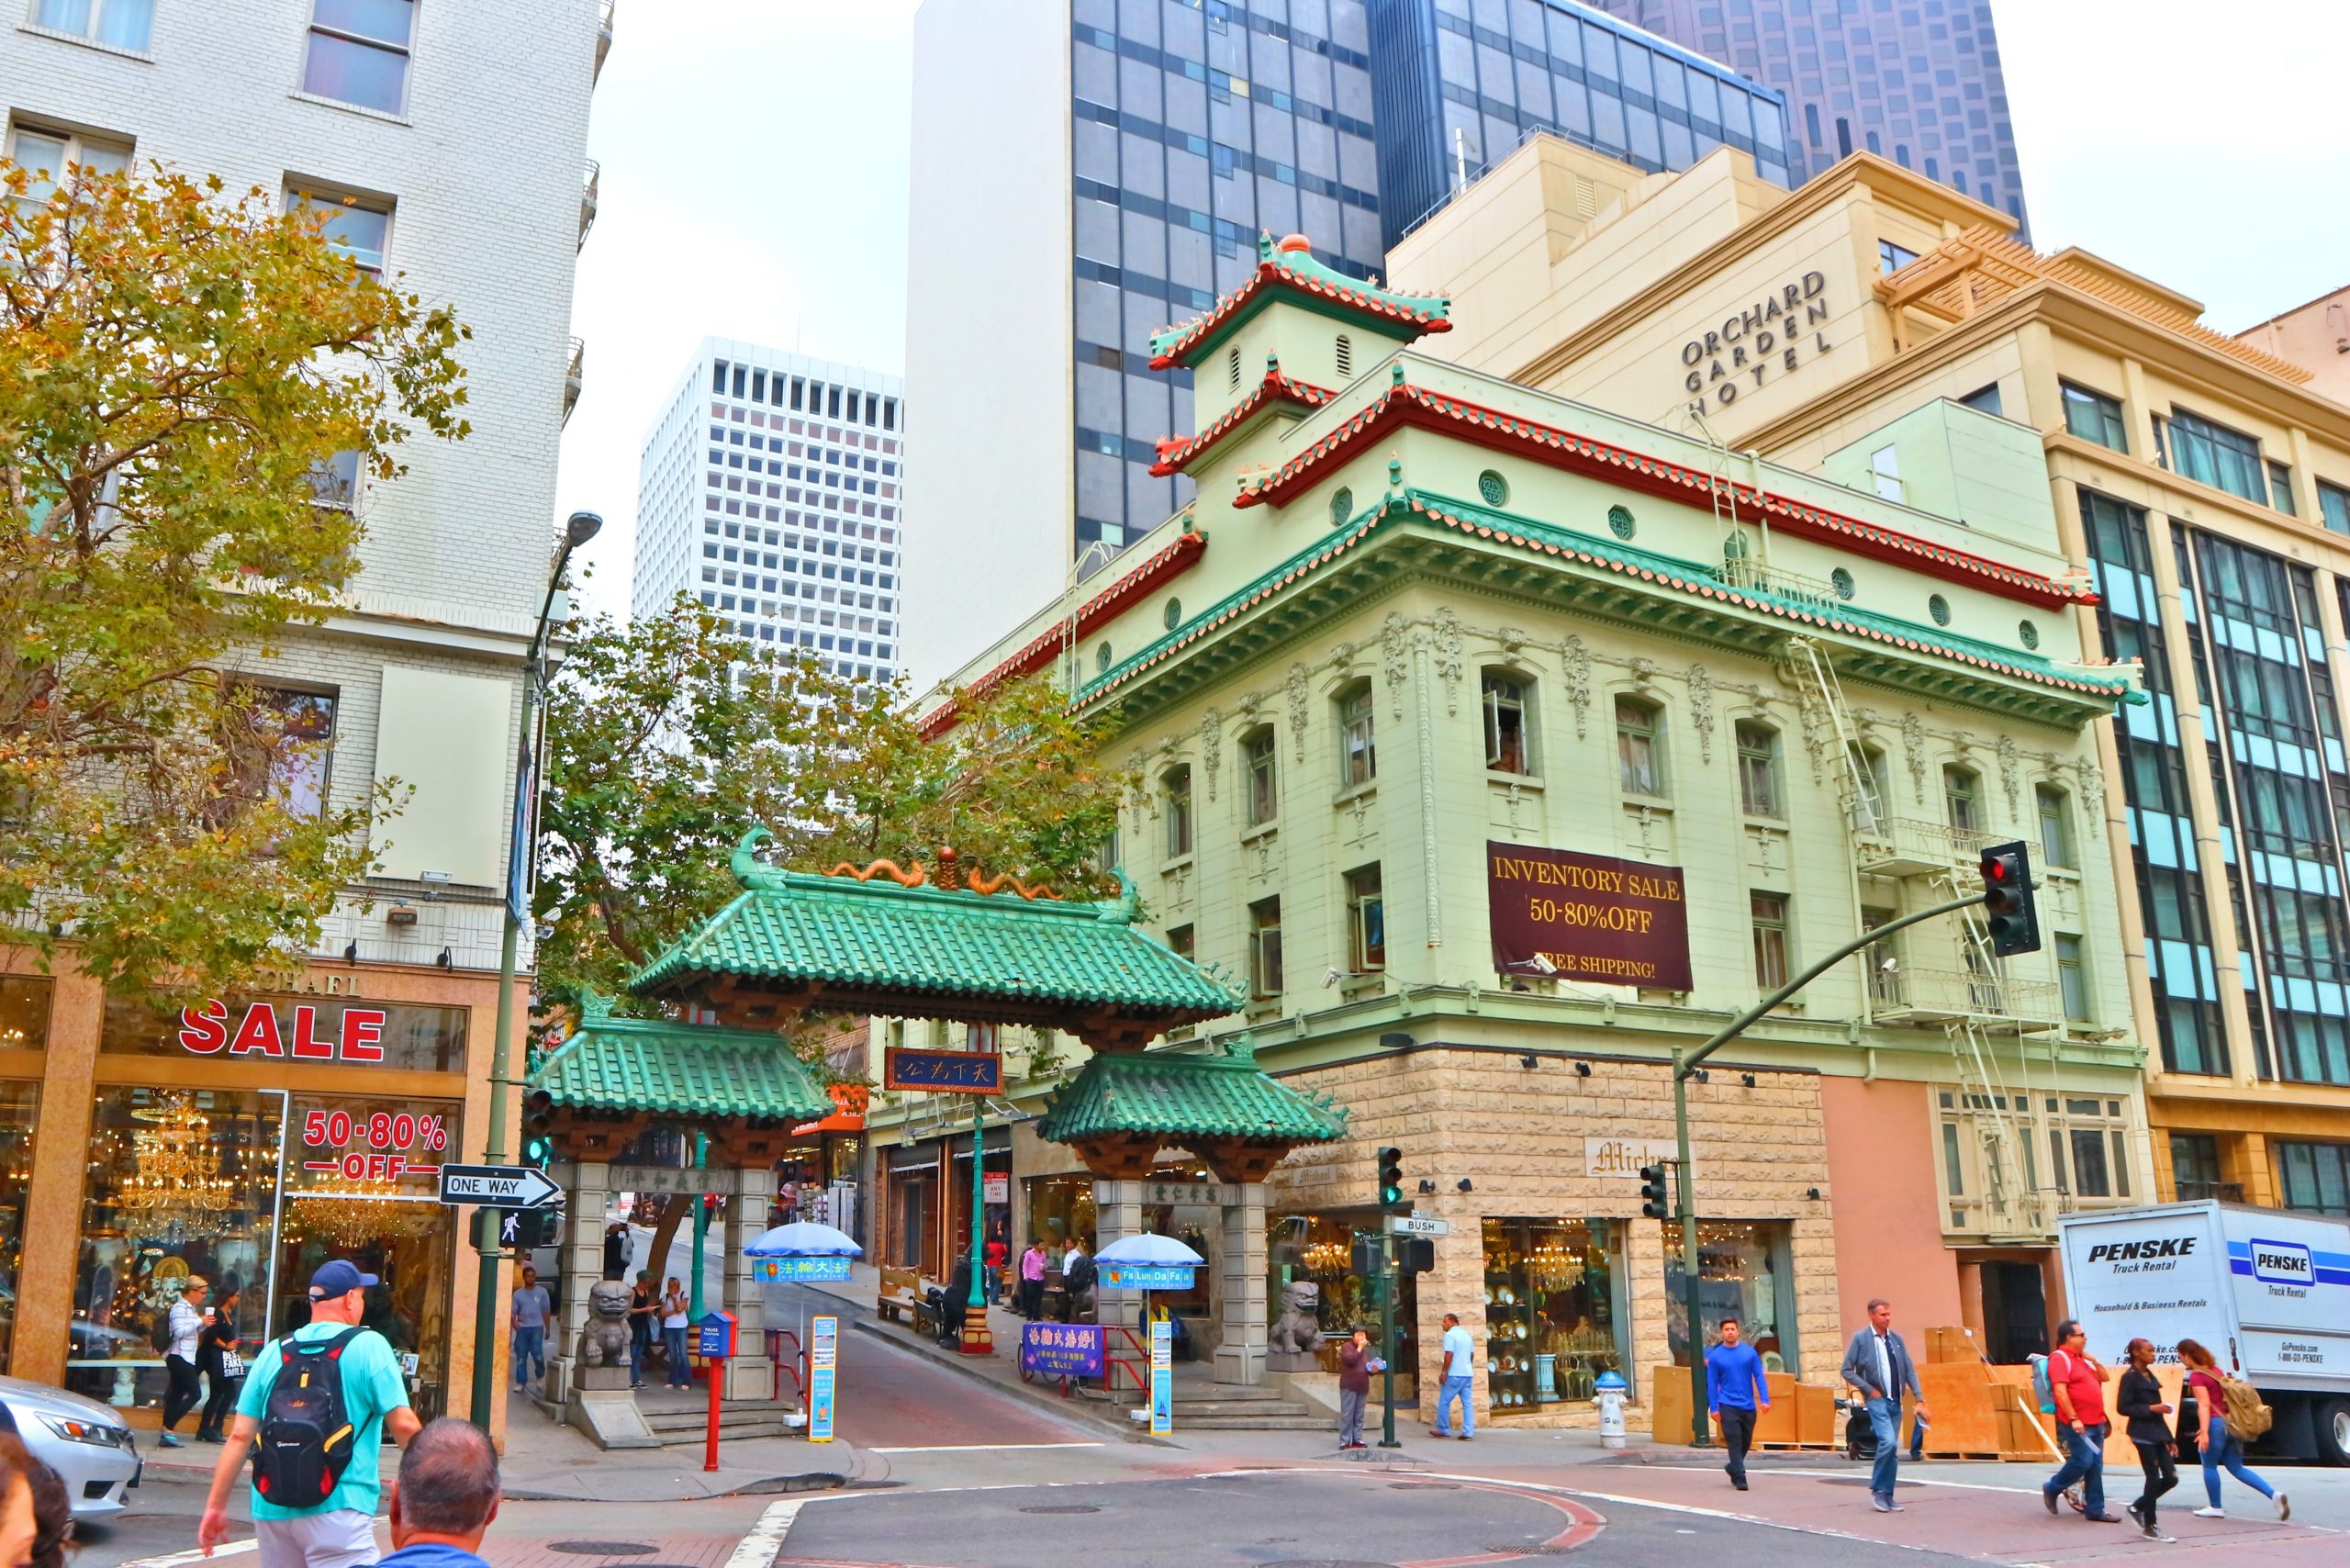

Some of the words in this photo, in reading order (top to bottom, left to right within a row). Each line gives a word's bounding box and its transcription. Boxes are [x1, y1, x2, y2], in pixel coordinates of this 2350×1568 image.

[1682, 271, 1825, 367] ORCHARD
[1684, 297, 1828, 393] GARDEN
[1688, 331, 1831, 420] HOTEL
[1494, 857, 1623, 893] INVENTORY
[1628, 875, 1680, 902] SALE
[1580, 957, 1656, 979] SHIPPING!
[256, 969, 363, 998] CHAEL
[179, 999, 386, 1061] SALE
[1592, 1141, 1681, 1174] Mich
[342, 1153, 407, 1181] OFF
[451, 1178, 481, 1193] ONE
[488, 1180, 520, 1194] WAY
[1408, 1221, 1435, 1231] BUSH
[2087, 1237, 2198, 1262] PENSKE
[2113, 1263, 2140, 1274] Truck
[2142, 1260, 2177, 1271] Rental
[2258, 1253, 2307, 1271] PENSKE
[1123, 1271, 1134, 1280] Fa
[1136, 1271, 1151, 1280] Lun
[1154, 1271, 1167, 1281] Da
[1169, 1271, 1181, 1281] Fa
[2268, 1285, 2285, 1296] Truck
[2287, 1287, 2307, 1298] Rental
[2094, 1302, 2132, 1312] Household
[2133, 1302, 2140, 1310] &
[2142, 1301, 2177, 1310] Business
[2177, 1299, 2208, 1308] Rentals
[2282, 1342, 2318, 1352] GoPenske.com
[224, 1359, 243, 1369] FAKE
[2278, 1352, 2323, 1364] 1-800-GO-PENSKE
[224, 1367, 245, 1377] SMILE
